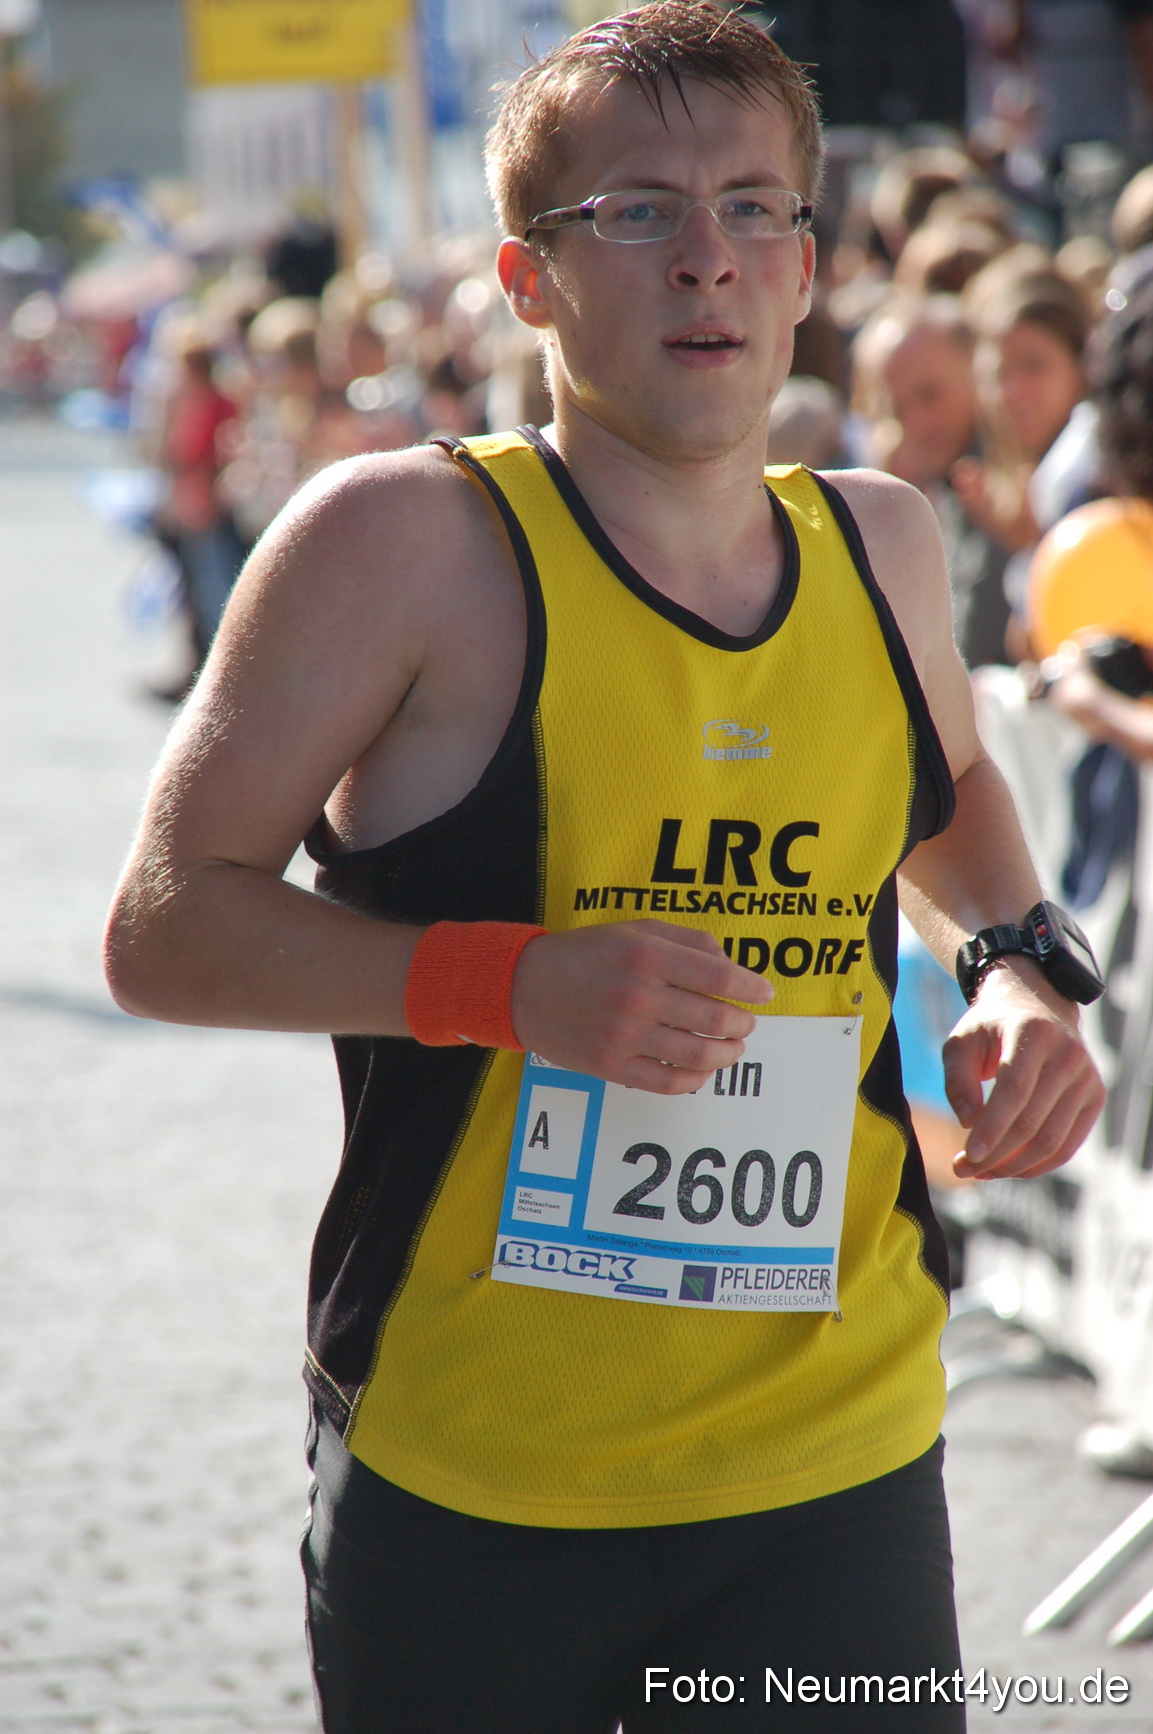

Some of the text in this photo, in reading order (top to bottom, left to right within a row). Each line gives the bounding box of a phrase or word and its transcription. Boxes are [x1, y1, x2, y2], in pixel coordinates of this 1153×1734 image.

[650, 818, 820, 888] LRC
[573, 886, 817, 916] MITTELSACHSEN
[723, 937, 865, 978] DORF
[528, 1111, 549, 1150] A
[612, 1142, 823, 1228] 2600
[500, 1240, 637, 1282] BOCK
[720, 1267, 831, 1290] PFLEIDERER
[718, 1294, 831, 1305] AKTIENGESELLSCHAFT
